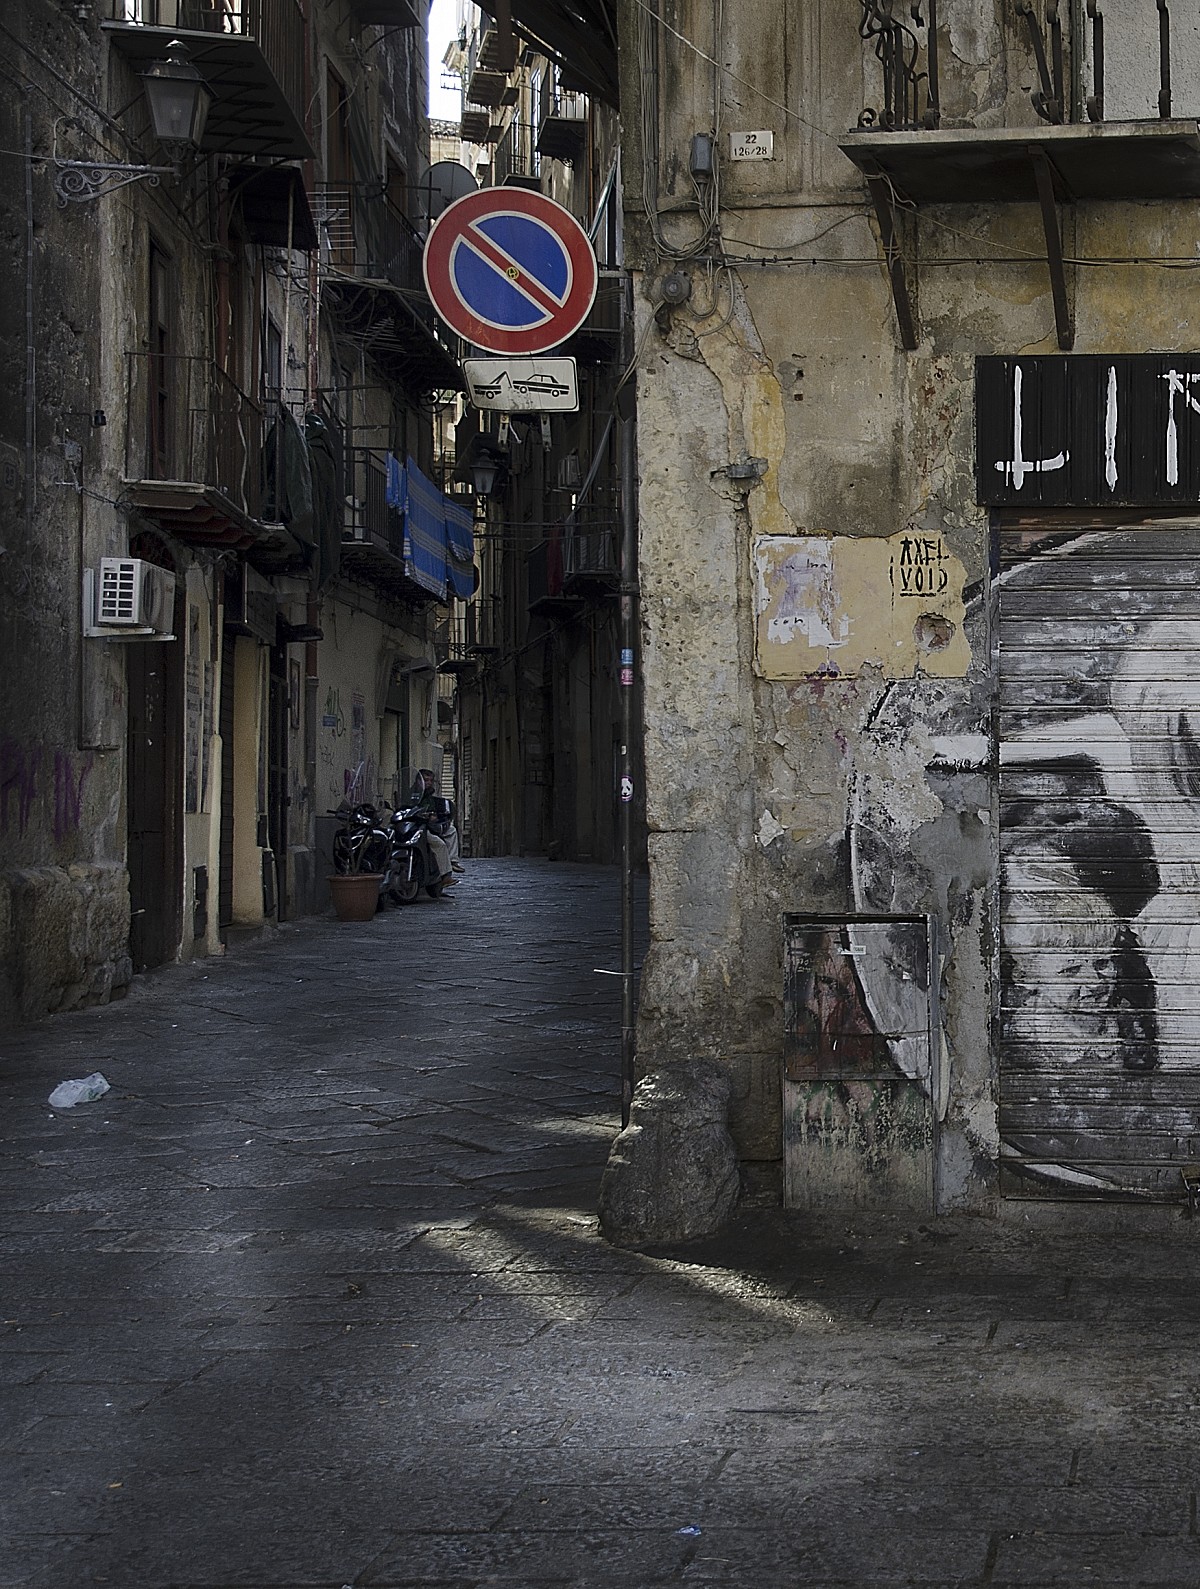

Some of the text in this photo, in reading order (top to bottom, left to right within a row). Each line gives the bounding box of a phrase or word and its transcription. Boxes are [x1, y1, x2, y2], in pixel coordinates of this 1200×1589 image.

[745, 134, 757, 144] 22
[734, 146, 767, 157] 126/28
[900, 536, 949, 566] AXEL
[900, 566, 948, 592] VOID
